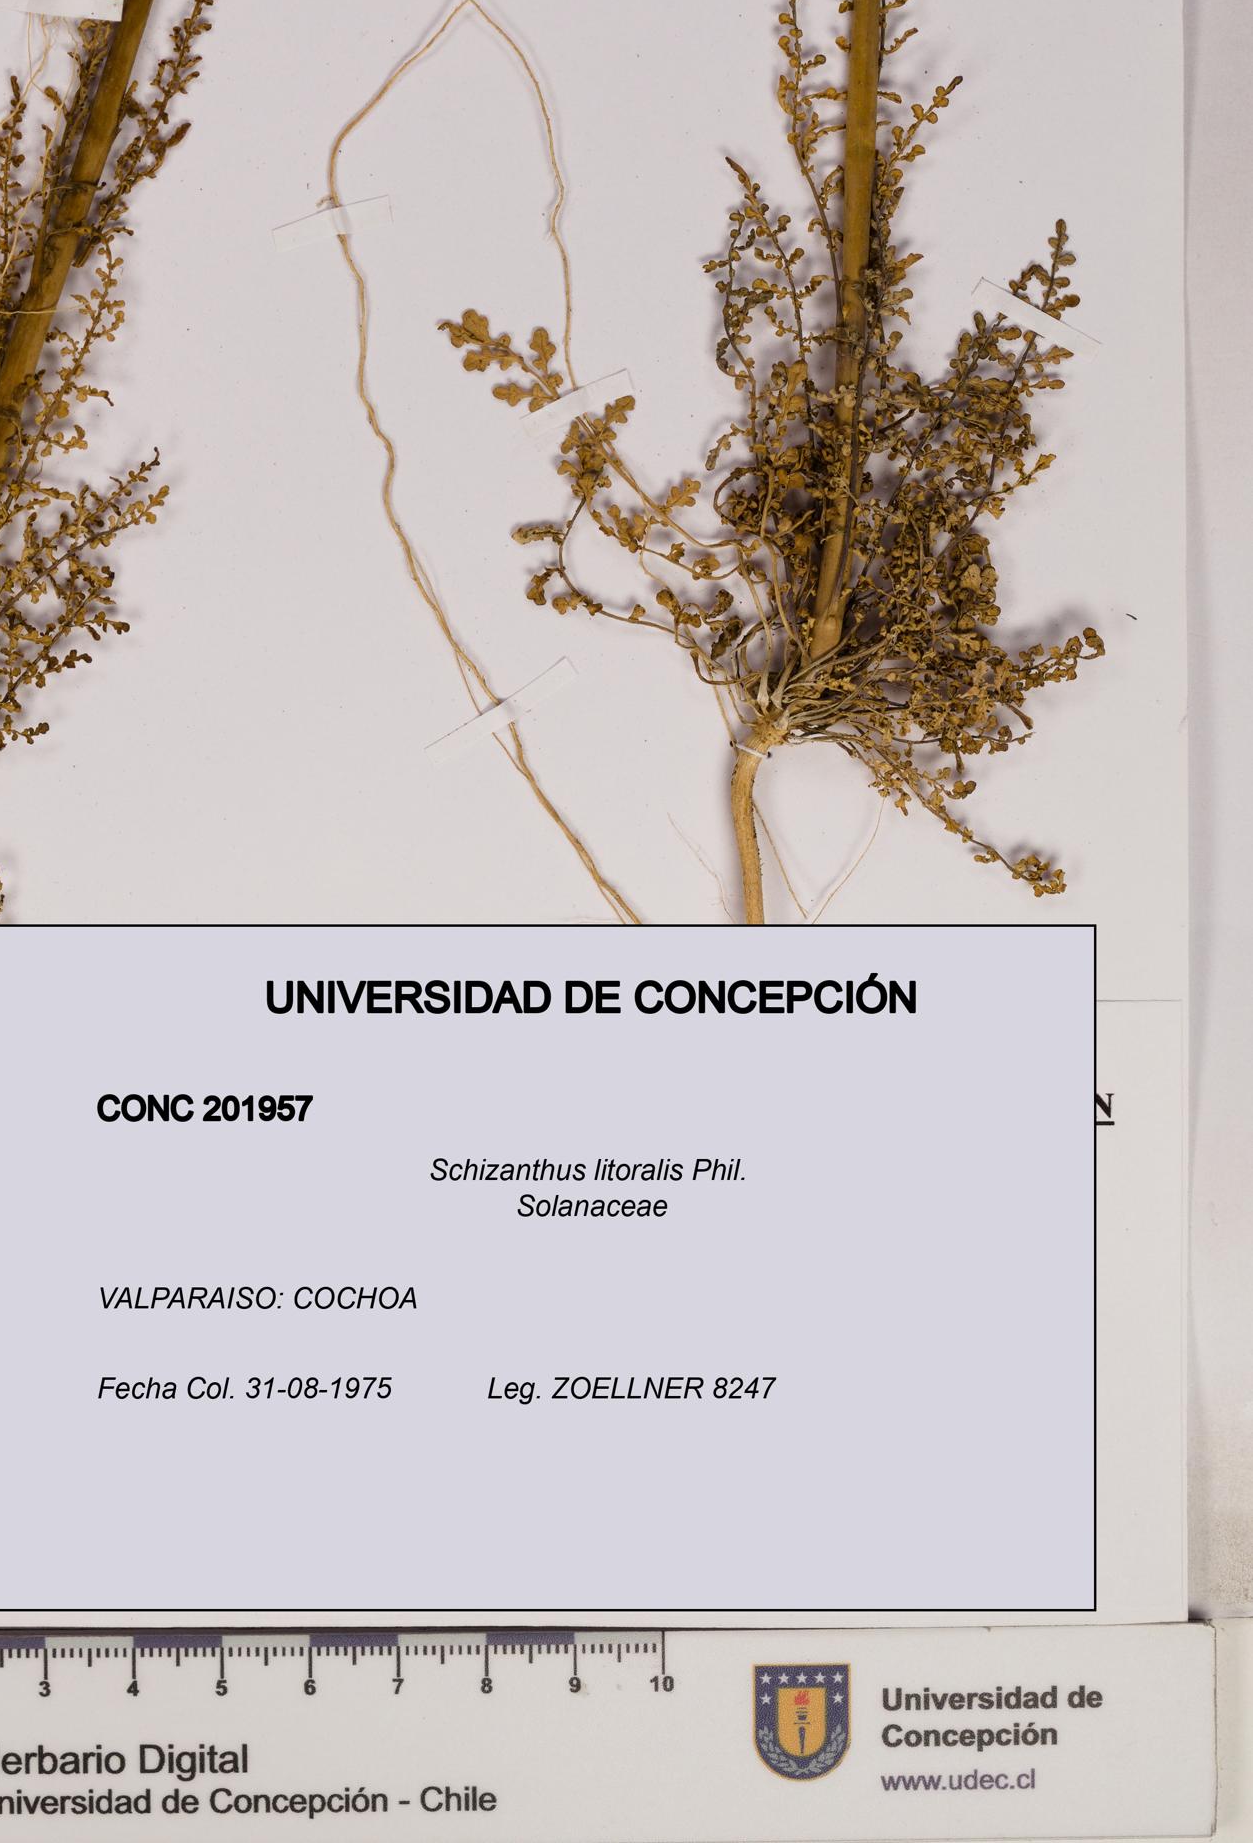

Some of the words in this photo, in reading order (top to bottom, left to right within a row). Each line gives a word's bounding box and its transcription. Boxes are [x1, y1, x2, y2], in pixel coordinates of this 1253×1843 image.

[38, 1680, 52, 1698] 3
[126, 1679, 140, 1697] 4
[214, 1678, 228, 1697] 5
[303, 1678, 317, 1696] 6
[391, 1678, 405, 1695] 7
[480, 1678, 494, 1695] 8
[568, 1678, 582, 1694] 9
[649, 1675, 675, 1693] 10
[882, 1685, 1058, 1712] Universidad
[1066, 1684, 1104, 1709] de
[881, 1722, 1058, 1752] Concepción
[139, 1743, 248, 1782] Digital
[880, 1769, 1035, 1791] www.udec.cl
[161, 1787, 200, 1815] de
[209, 1786, 389, 1820] Concepción
[419, 1785, 498, 1813] Chile
